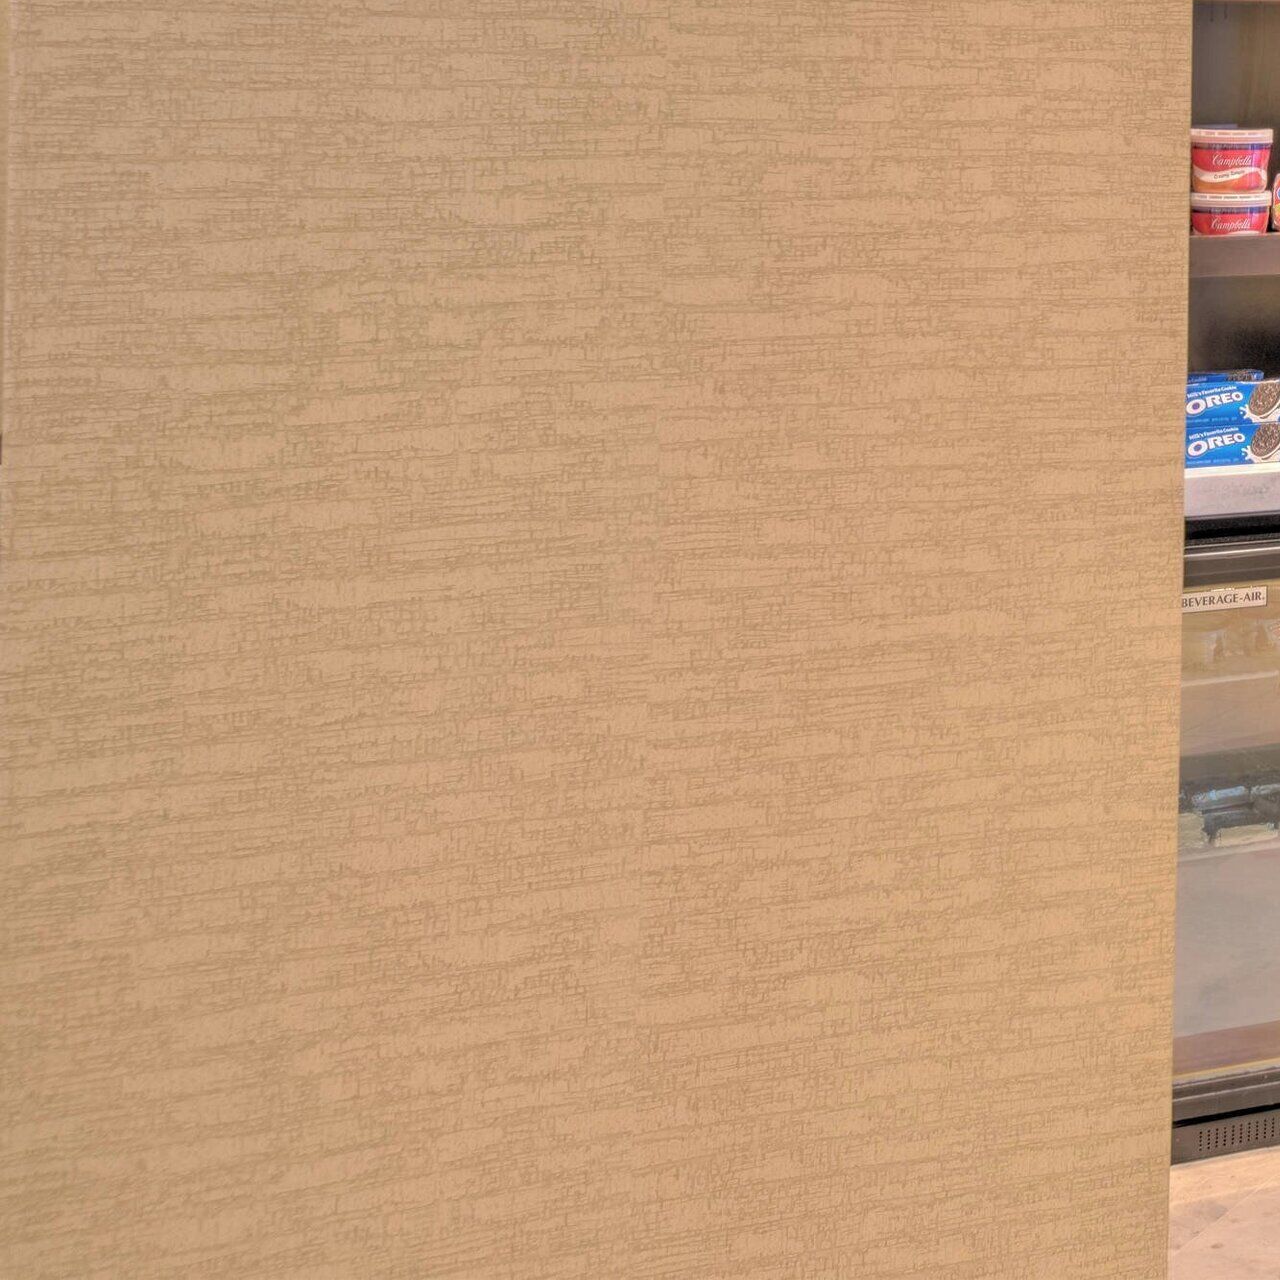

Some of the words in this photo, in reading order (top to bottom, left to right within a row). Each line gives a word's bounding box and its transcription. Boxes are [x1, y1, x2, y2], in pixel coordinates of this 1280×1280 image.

[1186, 391, 1244, 415] OREO
[1187, 433, 1245, 456] OREO
[1182, 591, 1262, 607] BEVERAGE-AIR
